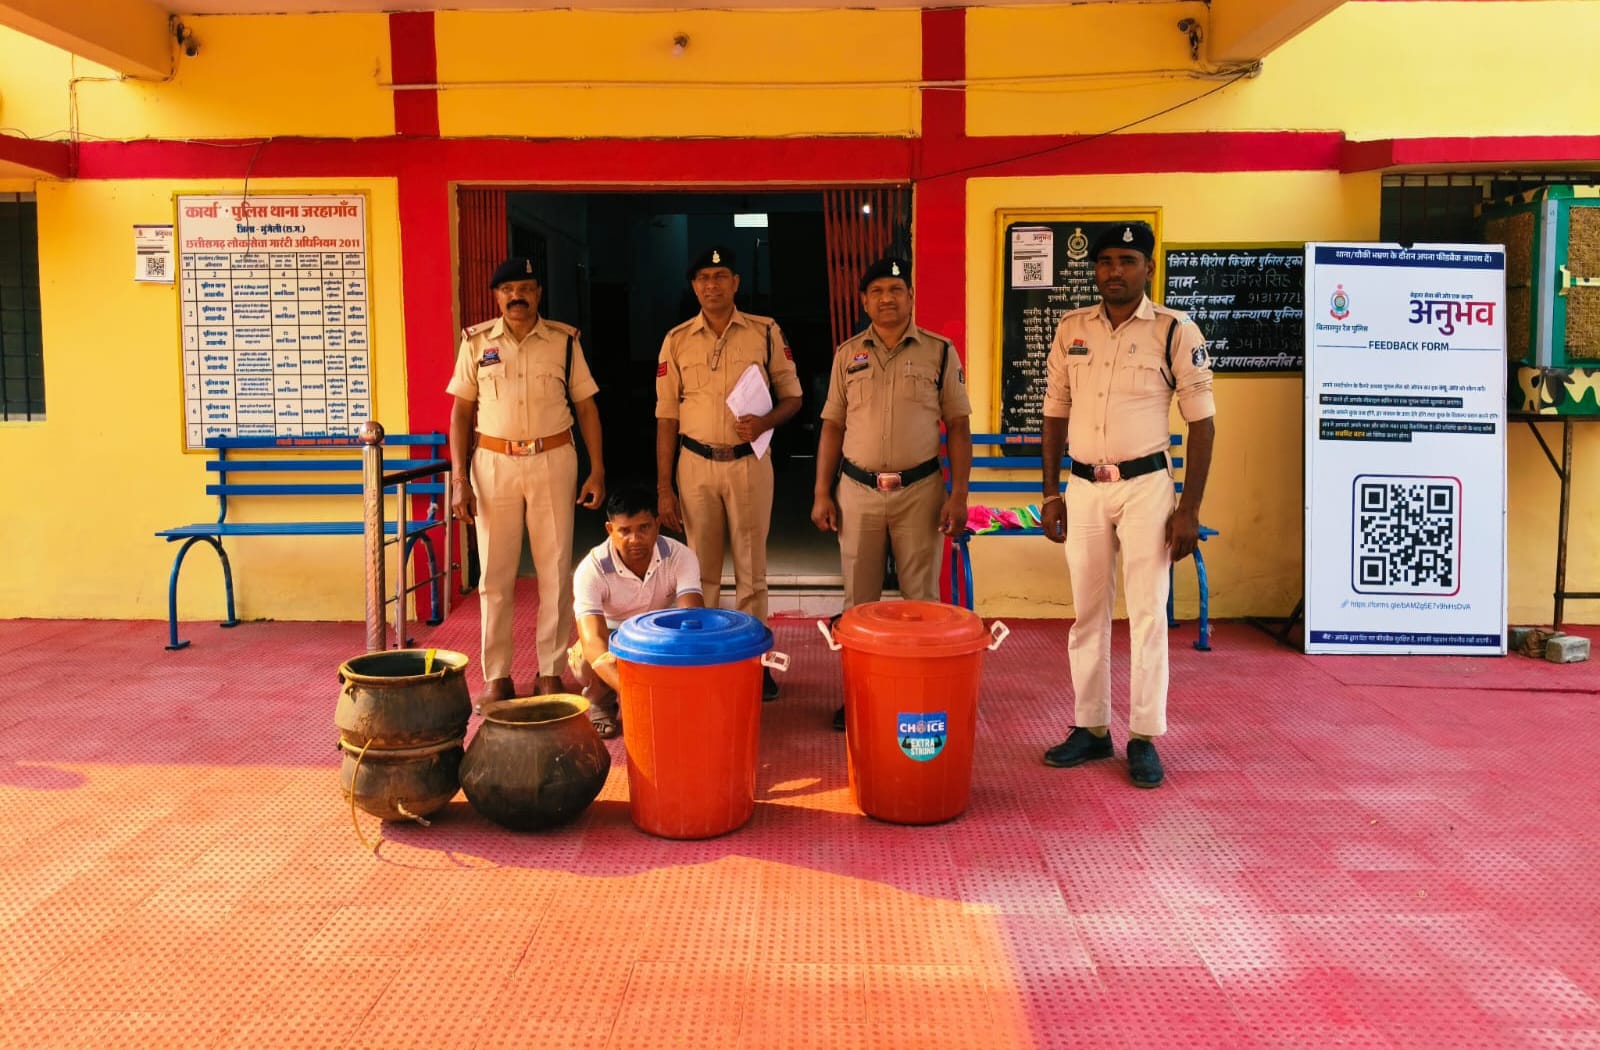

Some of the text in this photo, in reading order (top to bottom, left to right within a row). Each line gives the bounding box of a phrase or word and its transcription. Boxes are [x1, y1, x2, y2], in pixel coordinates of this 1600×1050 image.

[232, 203, 268, 220] पुलिस
[270, 205, 298, 218] थाना
[269, 238, 292, 248] गारंटी
[295, 238, 336, 248] अधिनियम
[338, 239, 360, 248] 2011
[1168, 252, 1189, 268] जिले
[1189, 252, 1198, 266] के
[1228, 252, 1257, 267] किशोर
[1258, 252, 1284, 270] पुलिस
[1284, 256, 1303, 268] इका
[1390, 250, 1397, 259] के
[1399, 250, 1416, 260] दौरान
[1436, 252, 1461, 262] फीडबैक
[1248, 292, 1302, 304] 91317771
[1198, 306, 1207, 320] के
[1232, 310, 1272, 319] कल्याण
[1273, 306, 1303, 323] पुलिस
[1409, 300, 1496, 336] अनुभव
[1352, 324, 1368, 334] पुलिस
[1368, 340, 1449, 351] FEEDBACK FORM
[1220, 352, 1296, 368] आपातकालीन
[900, 722, 944, 733] CHOICE
[911, 738, 935, 747] EXTRA
